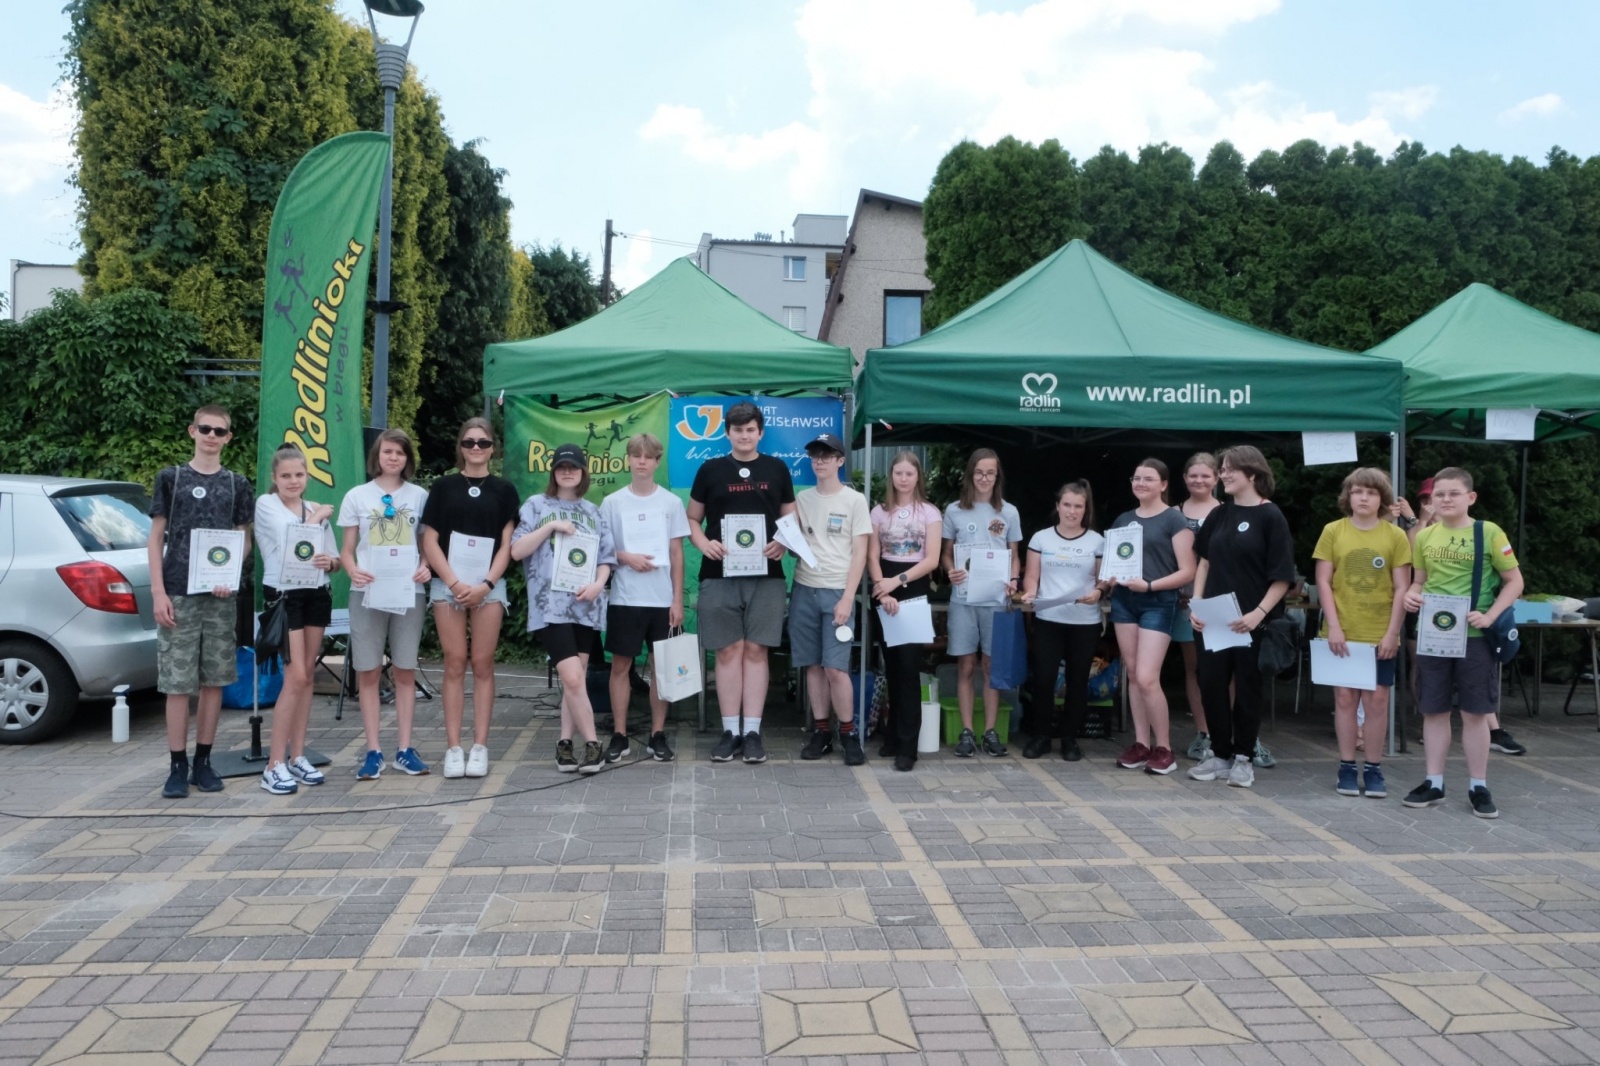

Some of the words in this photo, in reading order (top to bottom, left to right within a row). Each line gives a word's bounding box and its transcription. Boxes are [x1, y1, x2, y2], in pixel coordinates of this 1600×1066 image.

[283, 237, 365, 488] Radlinioki
[333, 326, 349, 396] biegu
[1020, 394, 1061, 407] radlin
[1086, 383, 1251, 409] www.radlin.pl
[335, 403, 343, 422] w
[757, 405, 778, 415] IAT
[764, 416, 834, 428] ZISŁAWSKI
[728, 484, 769, 492] SPORTSAR
